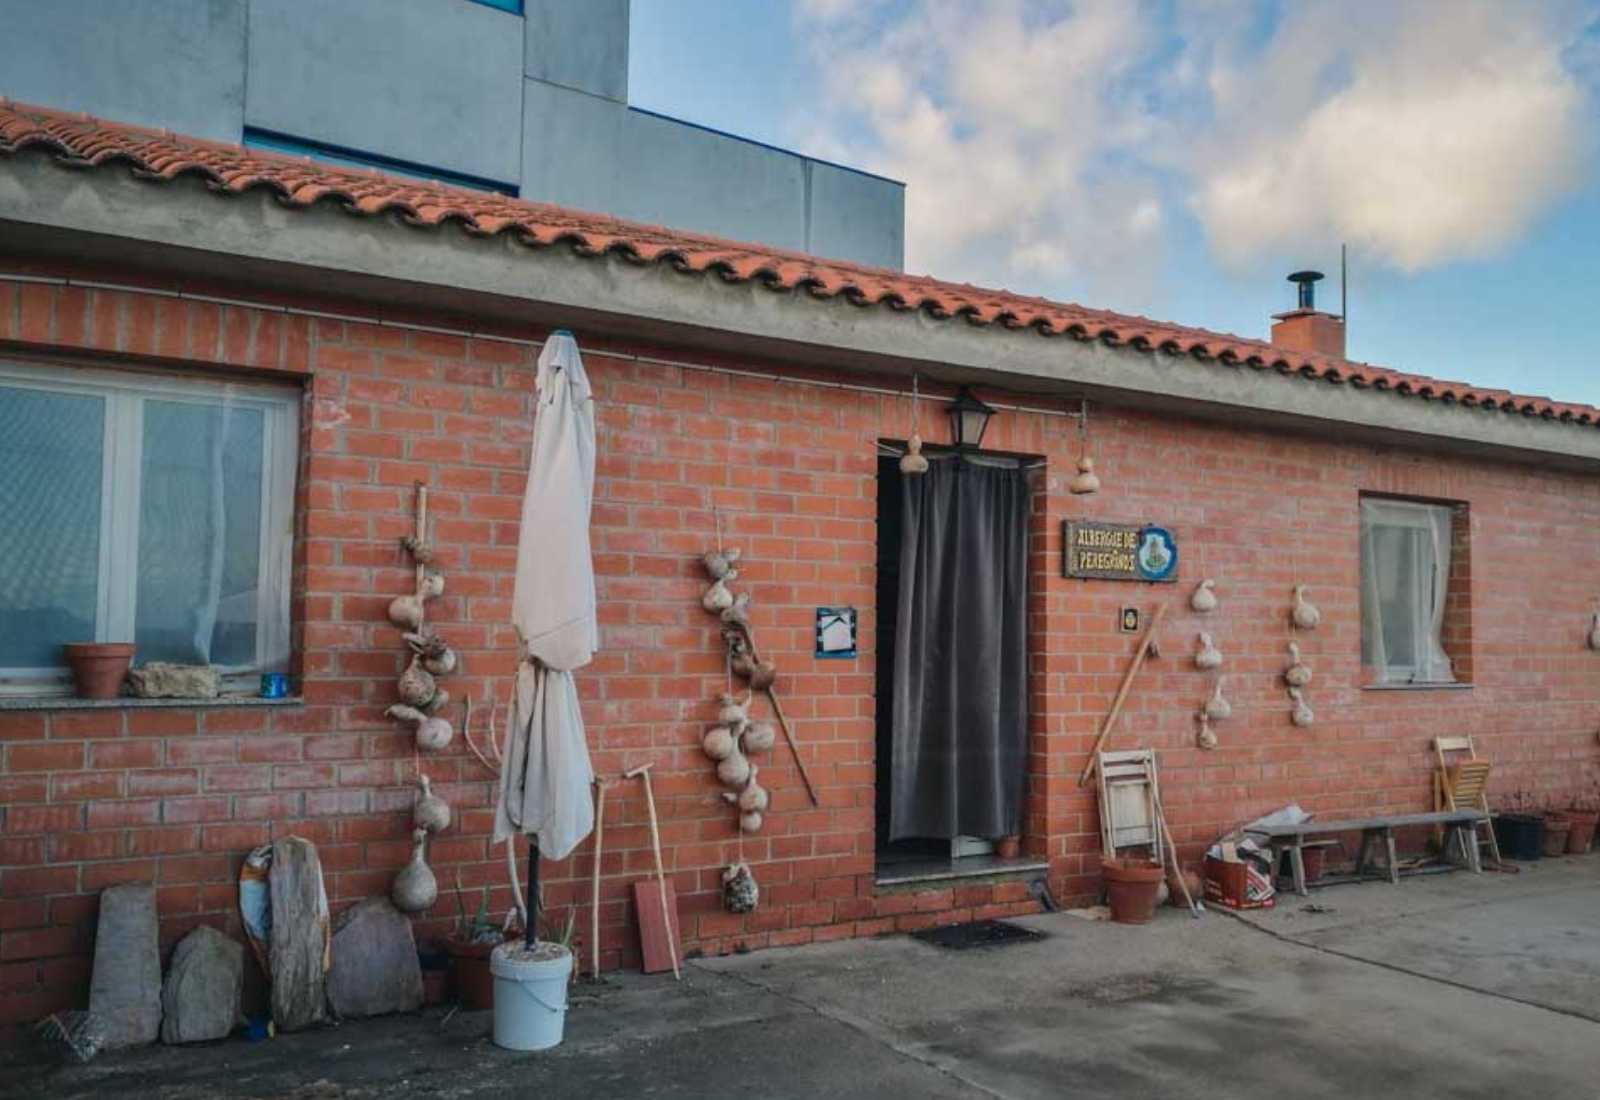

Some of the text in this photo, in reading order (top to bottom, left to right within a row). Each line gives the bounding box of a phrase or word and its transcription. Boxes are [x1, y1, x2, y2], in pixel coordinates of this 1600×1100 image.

[1078, 527, 1136, 548] ALBERGUE DE
[1079, 550, 1136, 570] PEREGRINOS
